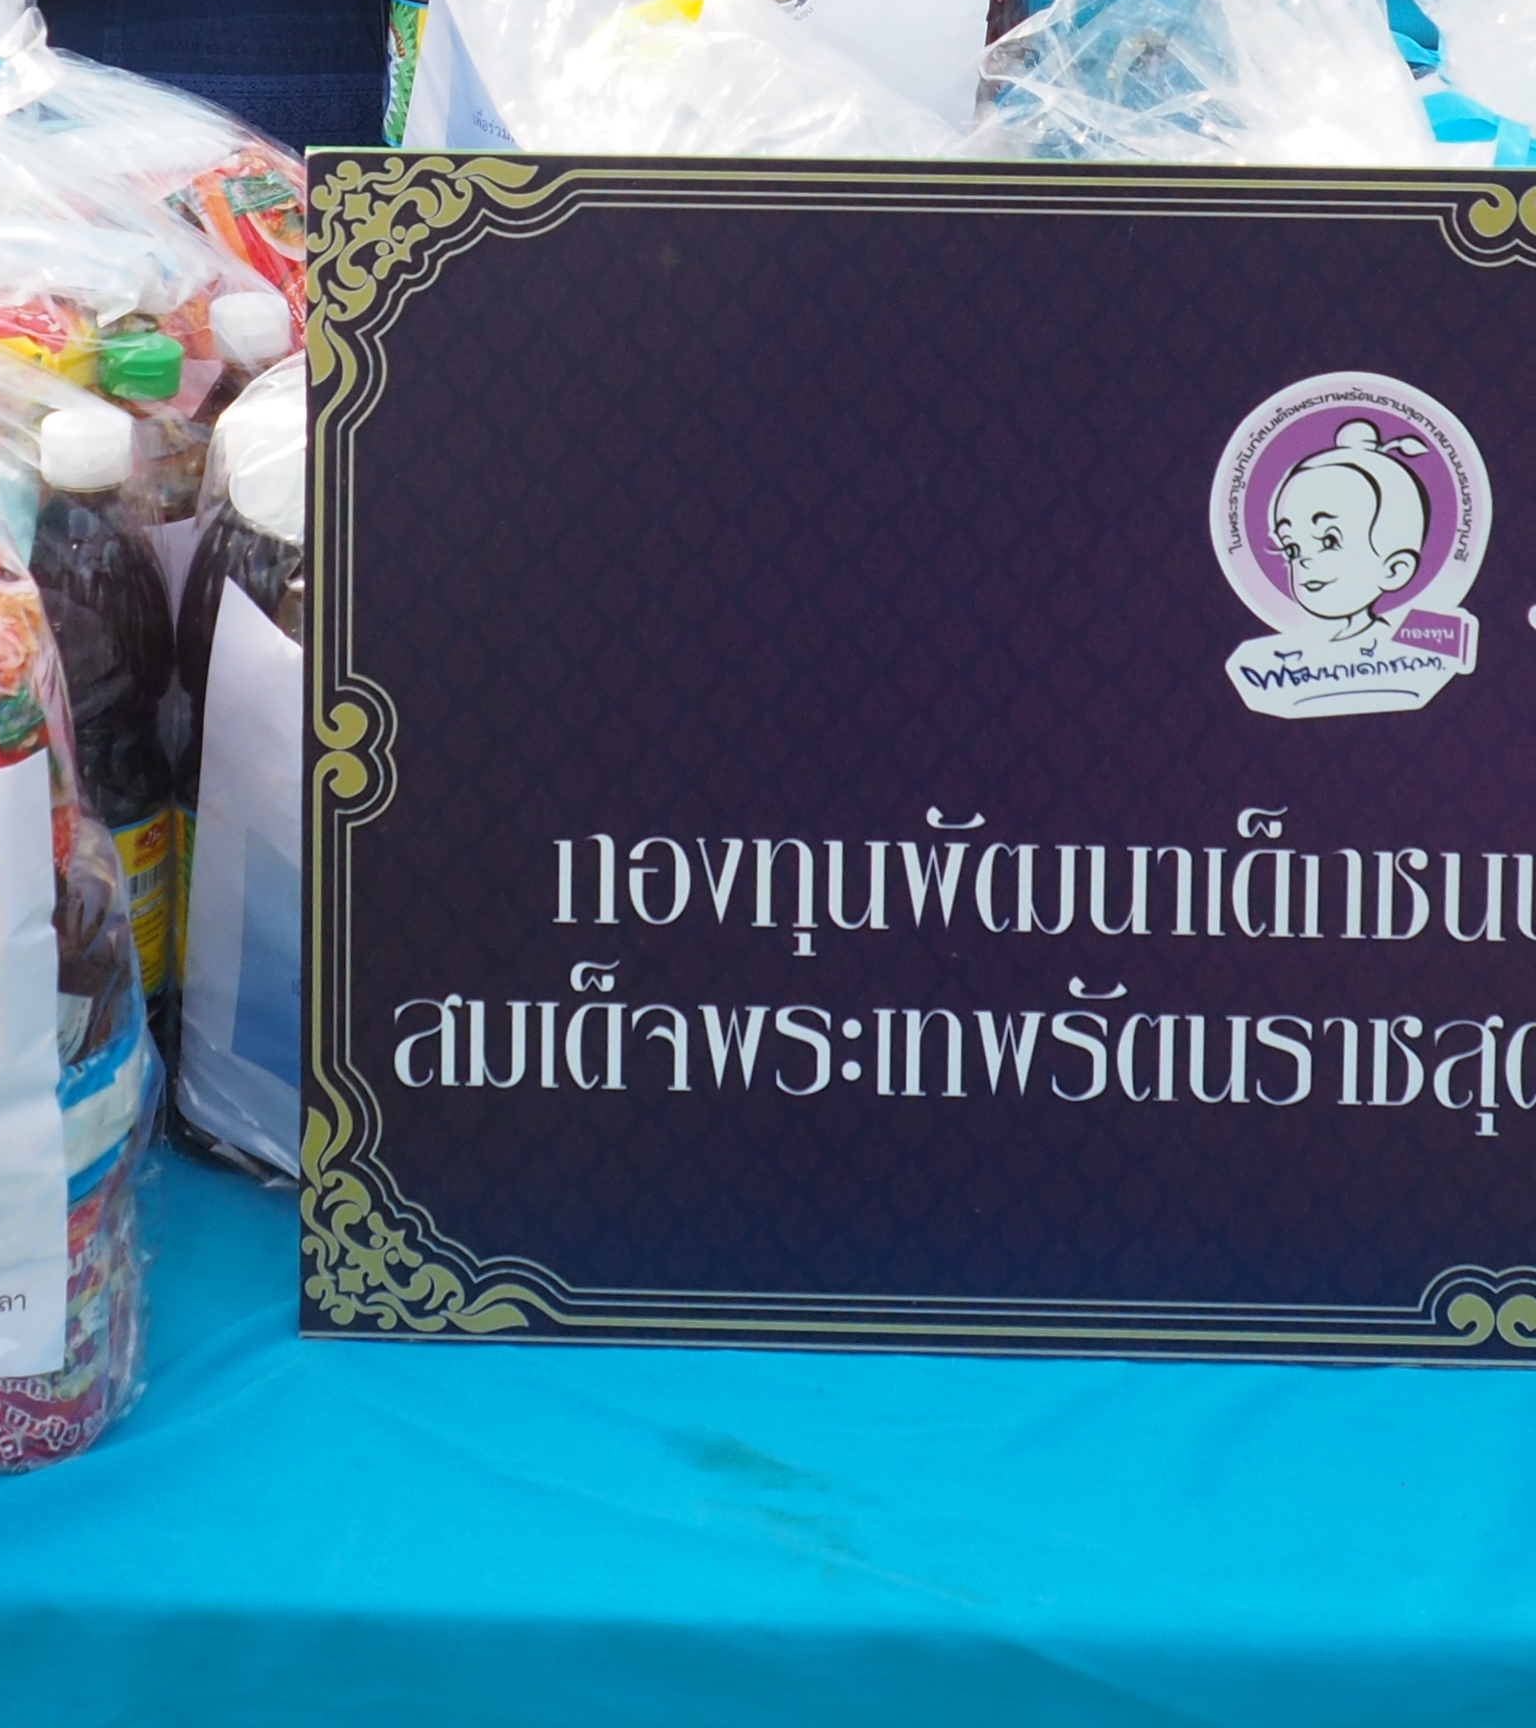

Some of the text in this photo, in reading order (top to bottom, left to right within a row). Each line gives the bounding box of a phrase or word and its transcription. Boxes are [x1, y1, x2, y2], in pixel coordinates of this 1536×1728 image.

[472, 108, 516, 143] เพื่อร่วม
[1399, 626, 1455, 647] กองทุน
